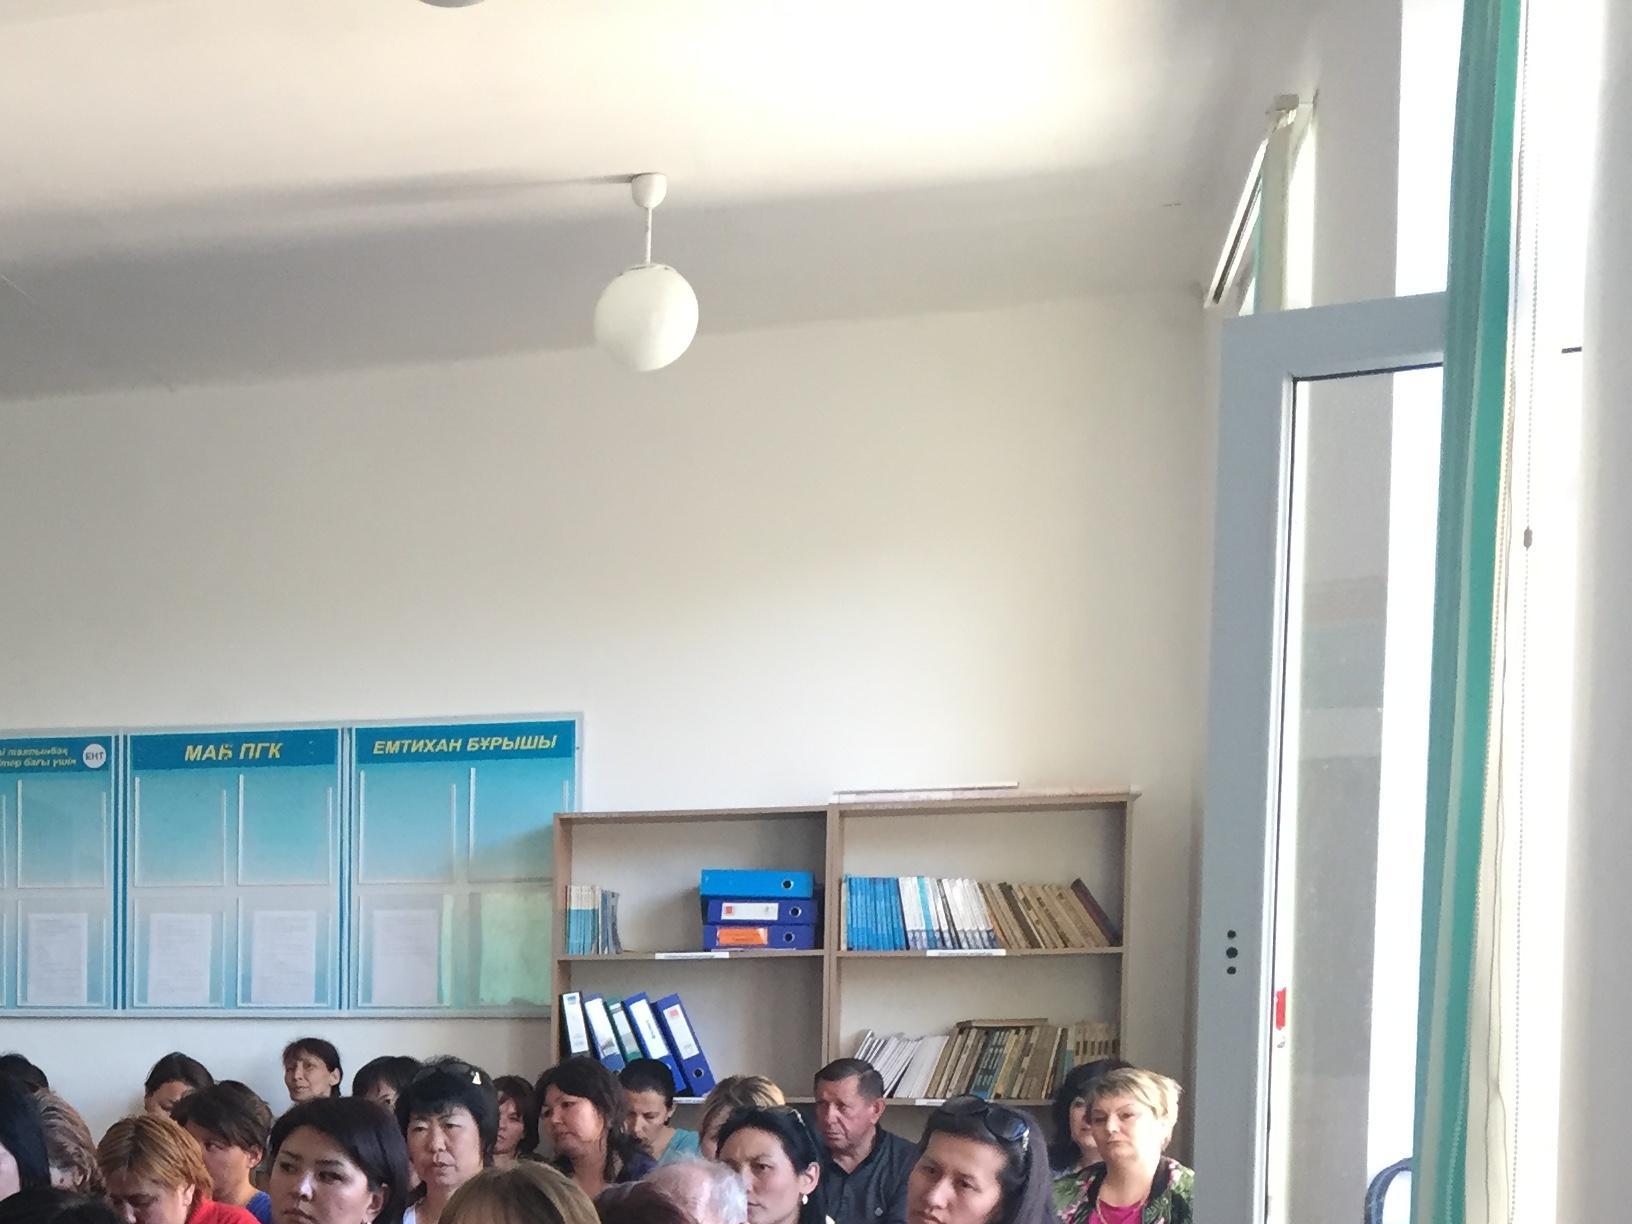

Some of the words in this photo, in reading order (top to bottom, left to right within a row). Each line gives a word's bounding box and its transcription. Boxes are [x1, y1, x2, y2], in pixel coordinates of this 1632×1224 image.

[239, 742, 284, 760] ПГК
[373, 738, 463, 755] ЕМТИХАН
[466, 735, 558, 752] БҰРЫШЫ
[85, 751, 104, 761] ЕНТ
